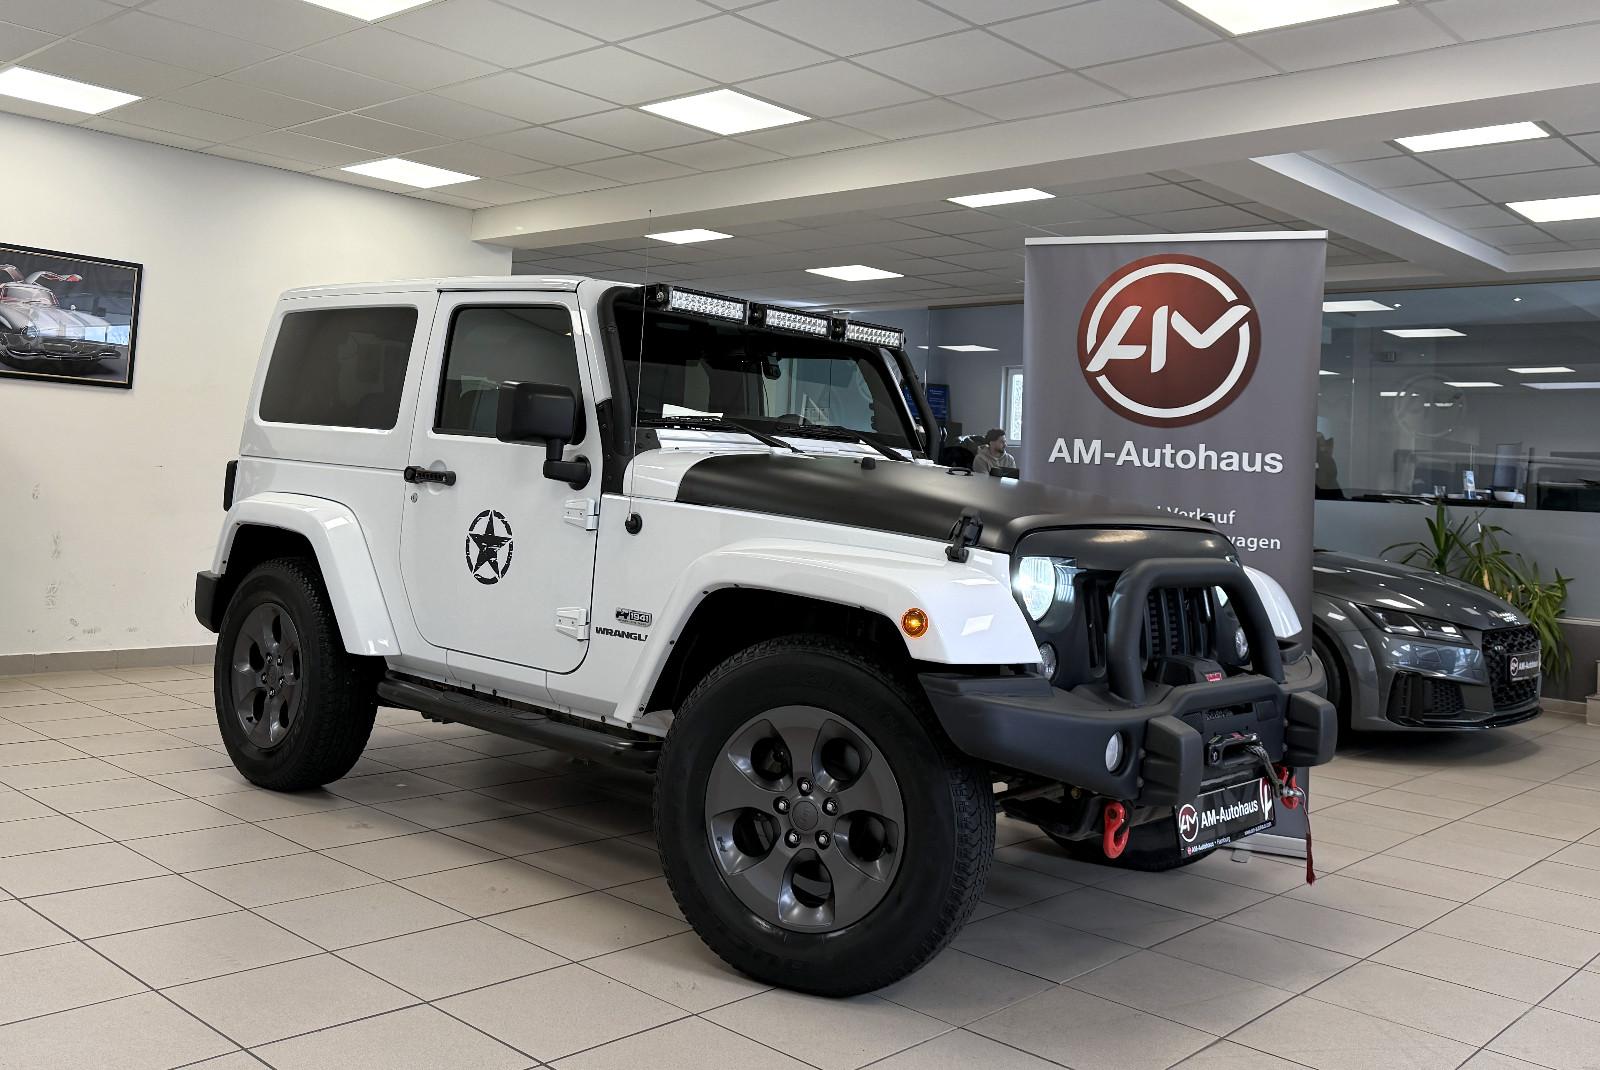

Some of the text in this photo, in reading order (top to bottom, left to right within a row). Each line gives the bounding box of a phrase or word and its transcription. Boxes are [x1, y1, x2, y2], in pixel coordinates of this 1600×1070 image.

[1048, 437, 1284, 474] AM-Autohaus
[630, 612, 650, 622] 1941
[1201, 800, 1259, 829] AM-Autohaus
